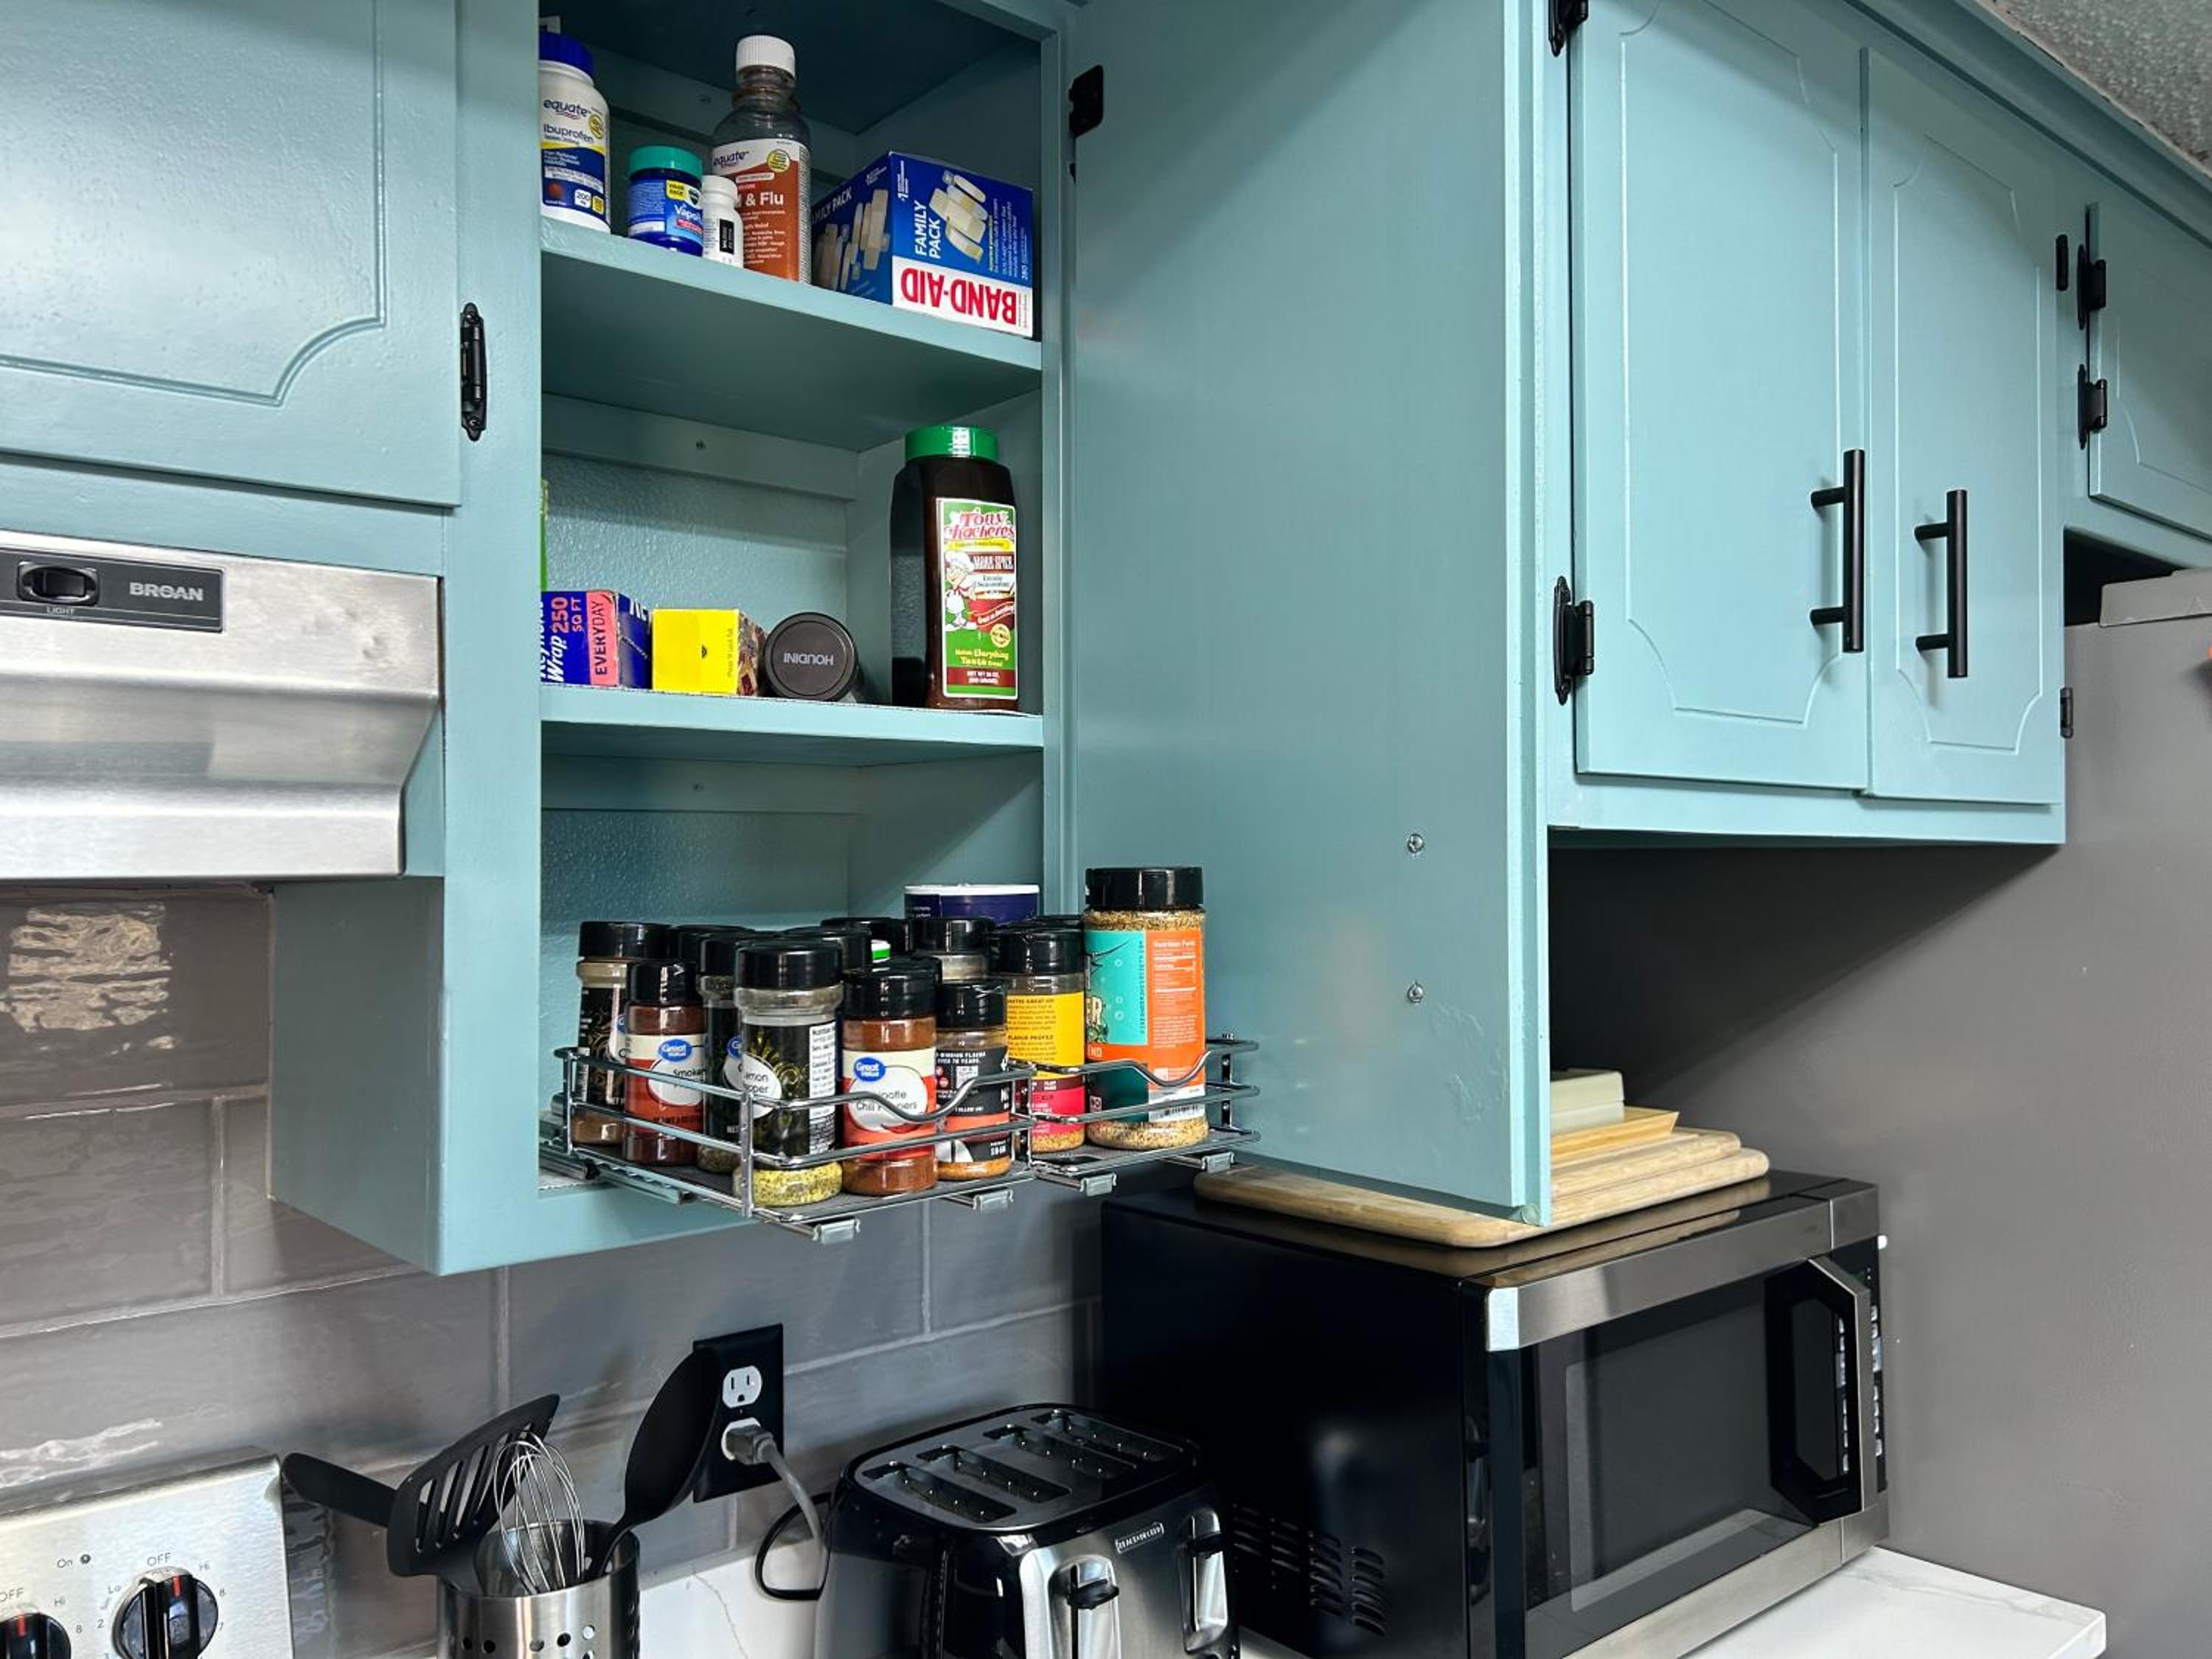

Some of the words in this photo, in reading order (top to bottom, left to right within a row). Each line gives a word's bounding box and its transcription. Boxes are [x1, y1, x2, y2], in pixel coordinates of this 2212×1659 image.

[543, 99, 589, 117] equate
[543, 123, 595, 144] Ibuprofen
[713, 150, 745, 167] equate
[745, 192, 756, 206] &
[760, 191, 784, 206] Flu
[832, 186, 852, 212] PACK
[914, 200, 927, 256] FAMILY
[928, 218, 942, 259] PACK
[900, 267, 1017, 325] BAND-AID
[129, 582, 204, 602] BROAN
[46, 606, 76, 616] LIGHT
[571, 597, 582, 611] FT
[552, 597, 569, 633] 250
[571, 614, 582, 633] SQ
[591, 601, 608, 675] EVERYDAY
[546, 635, 568, 683] Wrap
[784, 653, 834, 666] HOUDINI
[960, 655, 987, 666] Taste
[974, 648, 1009, 661] Everything
[856, 1062, 880, 1071] Great
[57, 1558, 73, 1568] On
[147, 1552, 172, 1567] OFF
[108, 1585, 122, 1594] Lo
[76, 1625, 83, 1634] 8
[97, 1618, 105, 1629] 2
